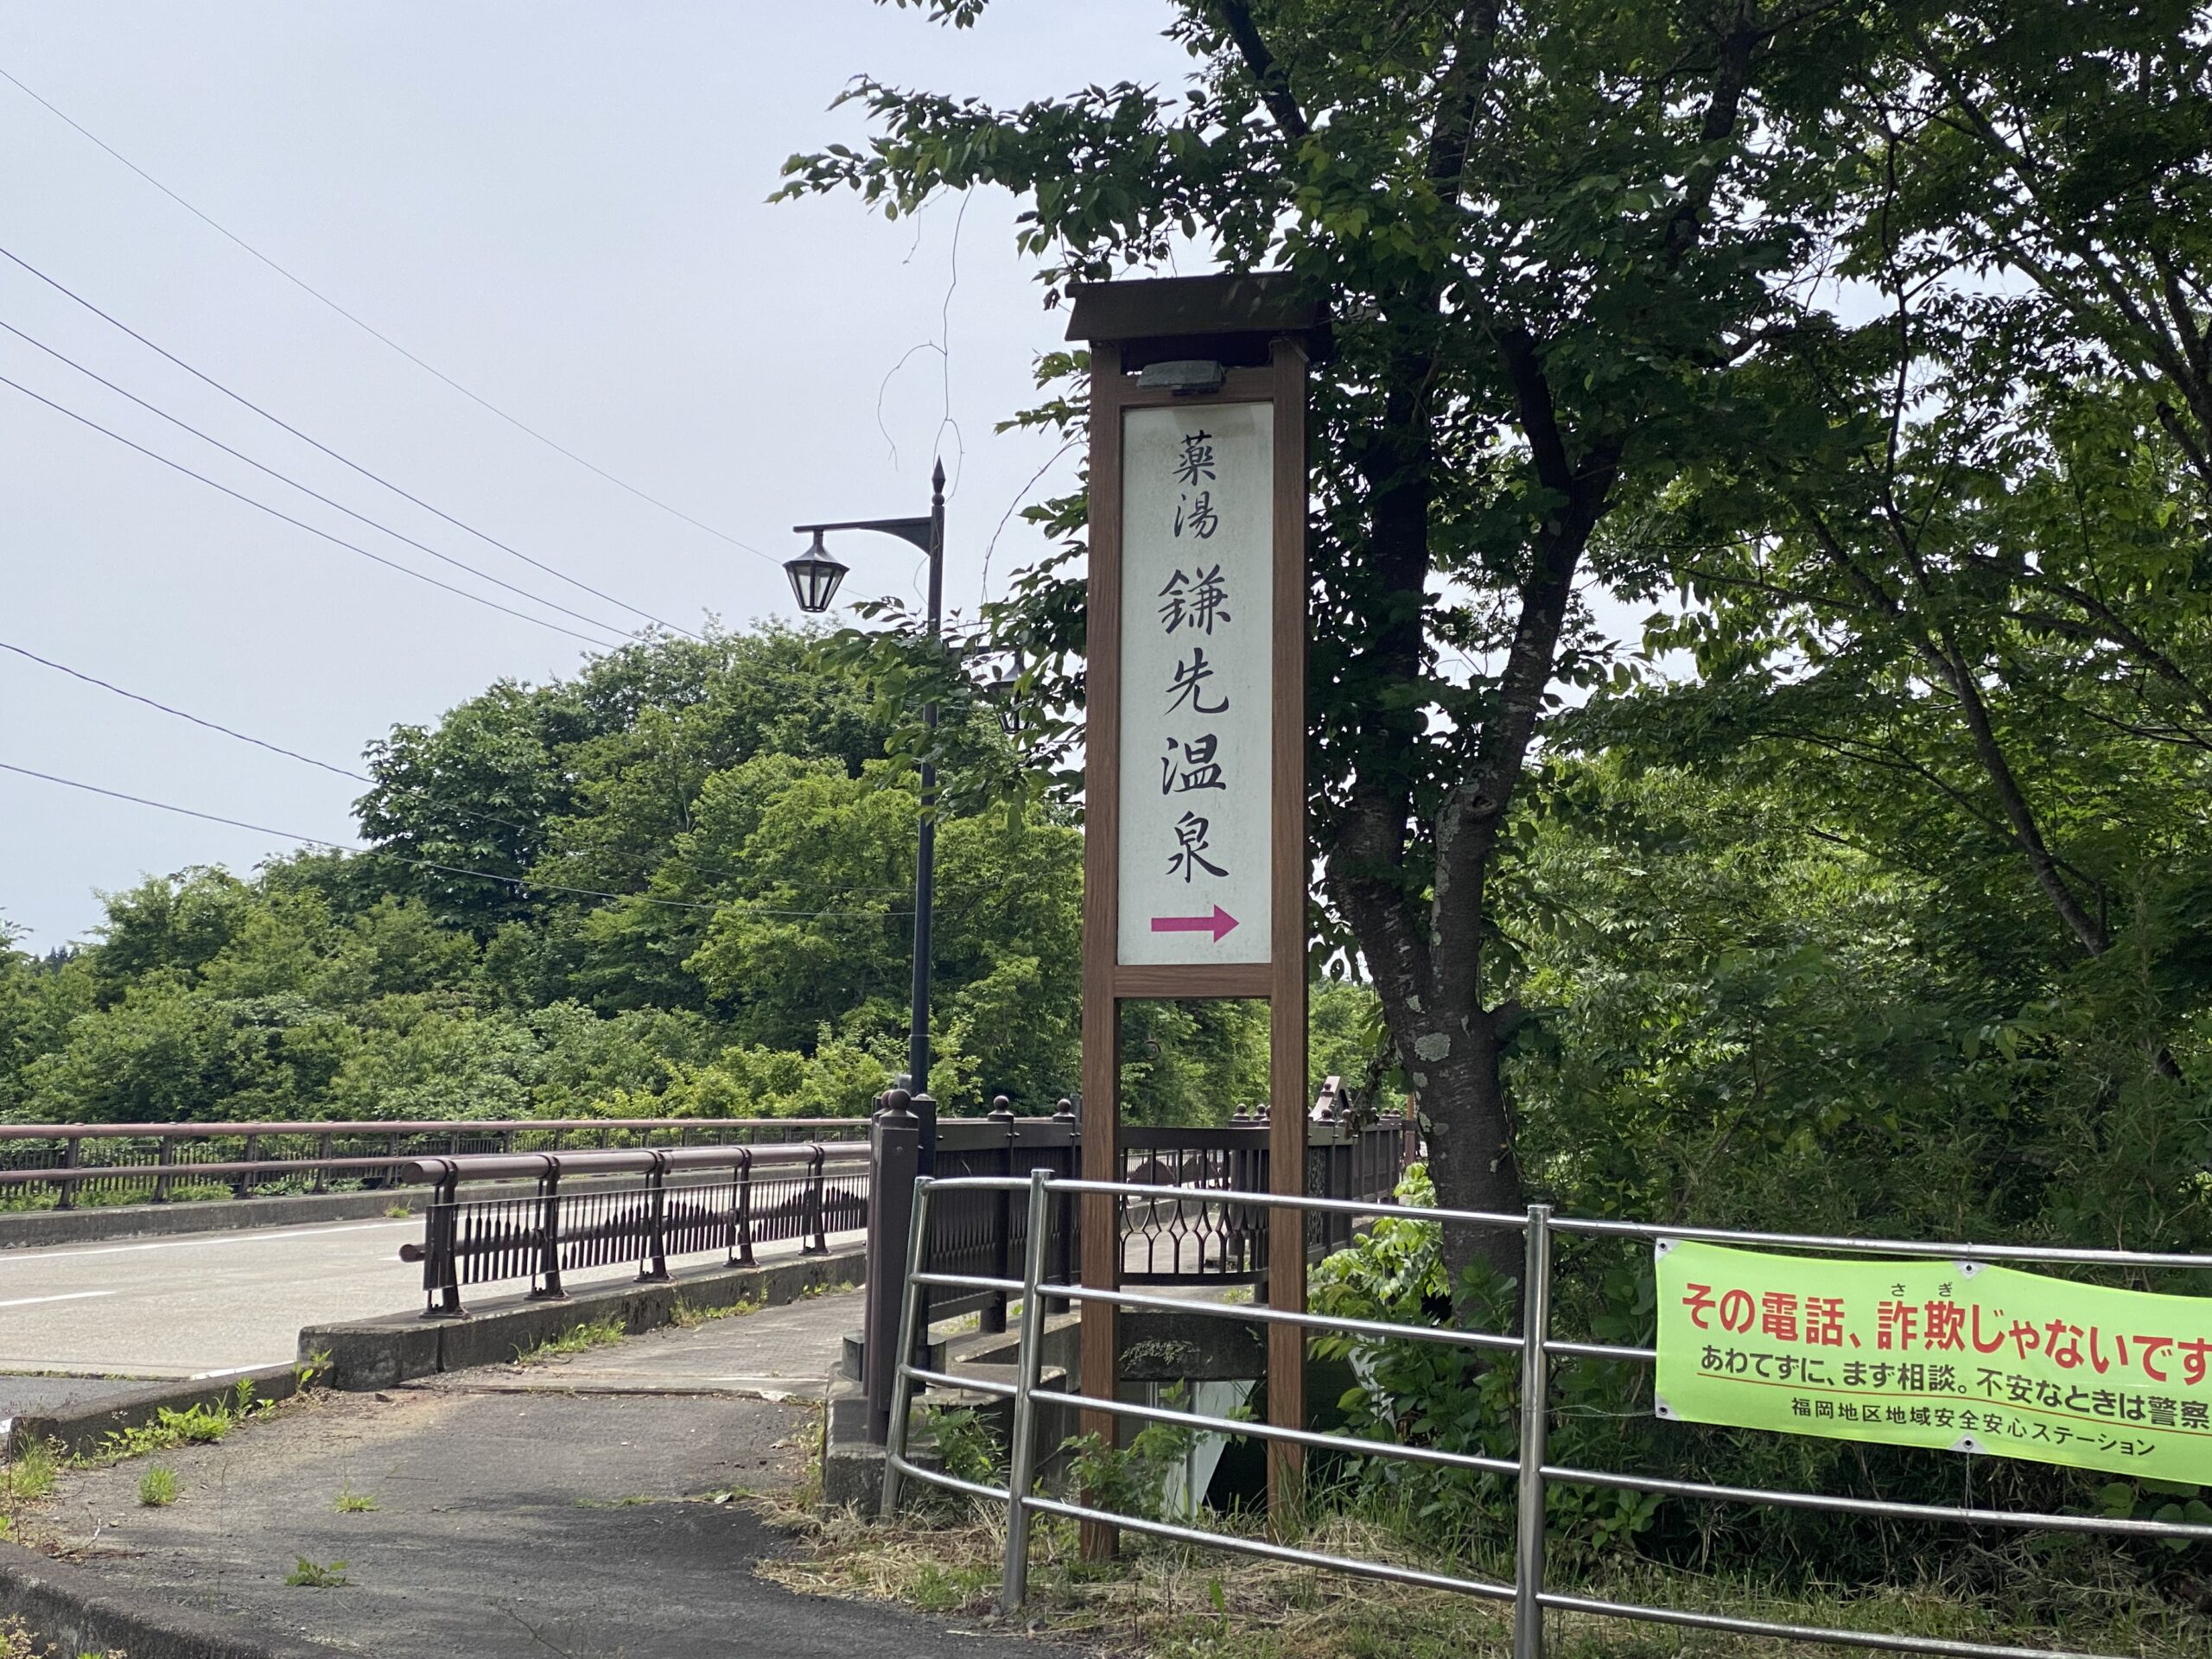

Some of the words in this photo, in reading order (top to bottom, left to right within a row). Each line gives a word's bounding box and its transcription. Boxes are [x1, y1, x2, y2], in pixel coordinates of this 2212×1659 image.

[1791, 1397, 2155, 1457] 福岡地区地域安全安心ステーション
